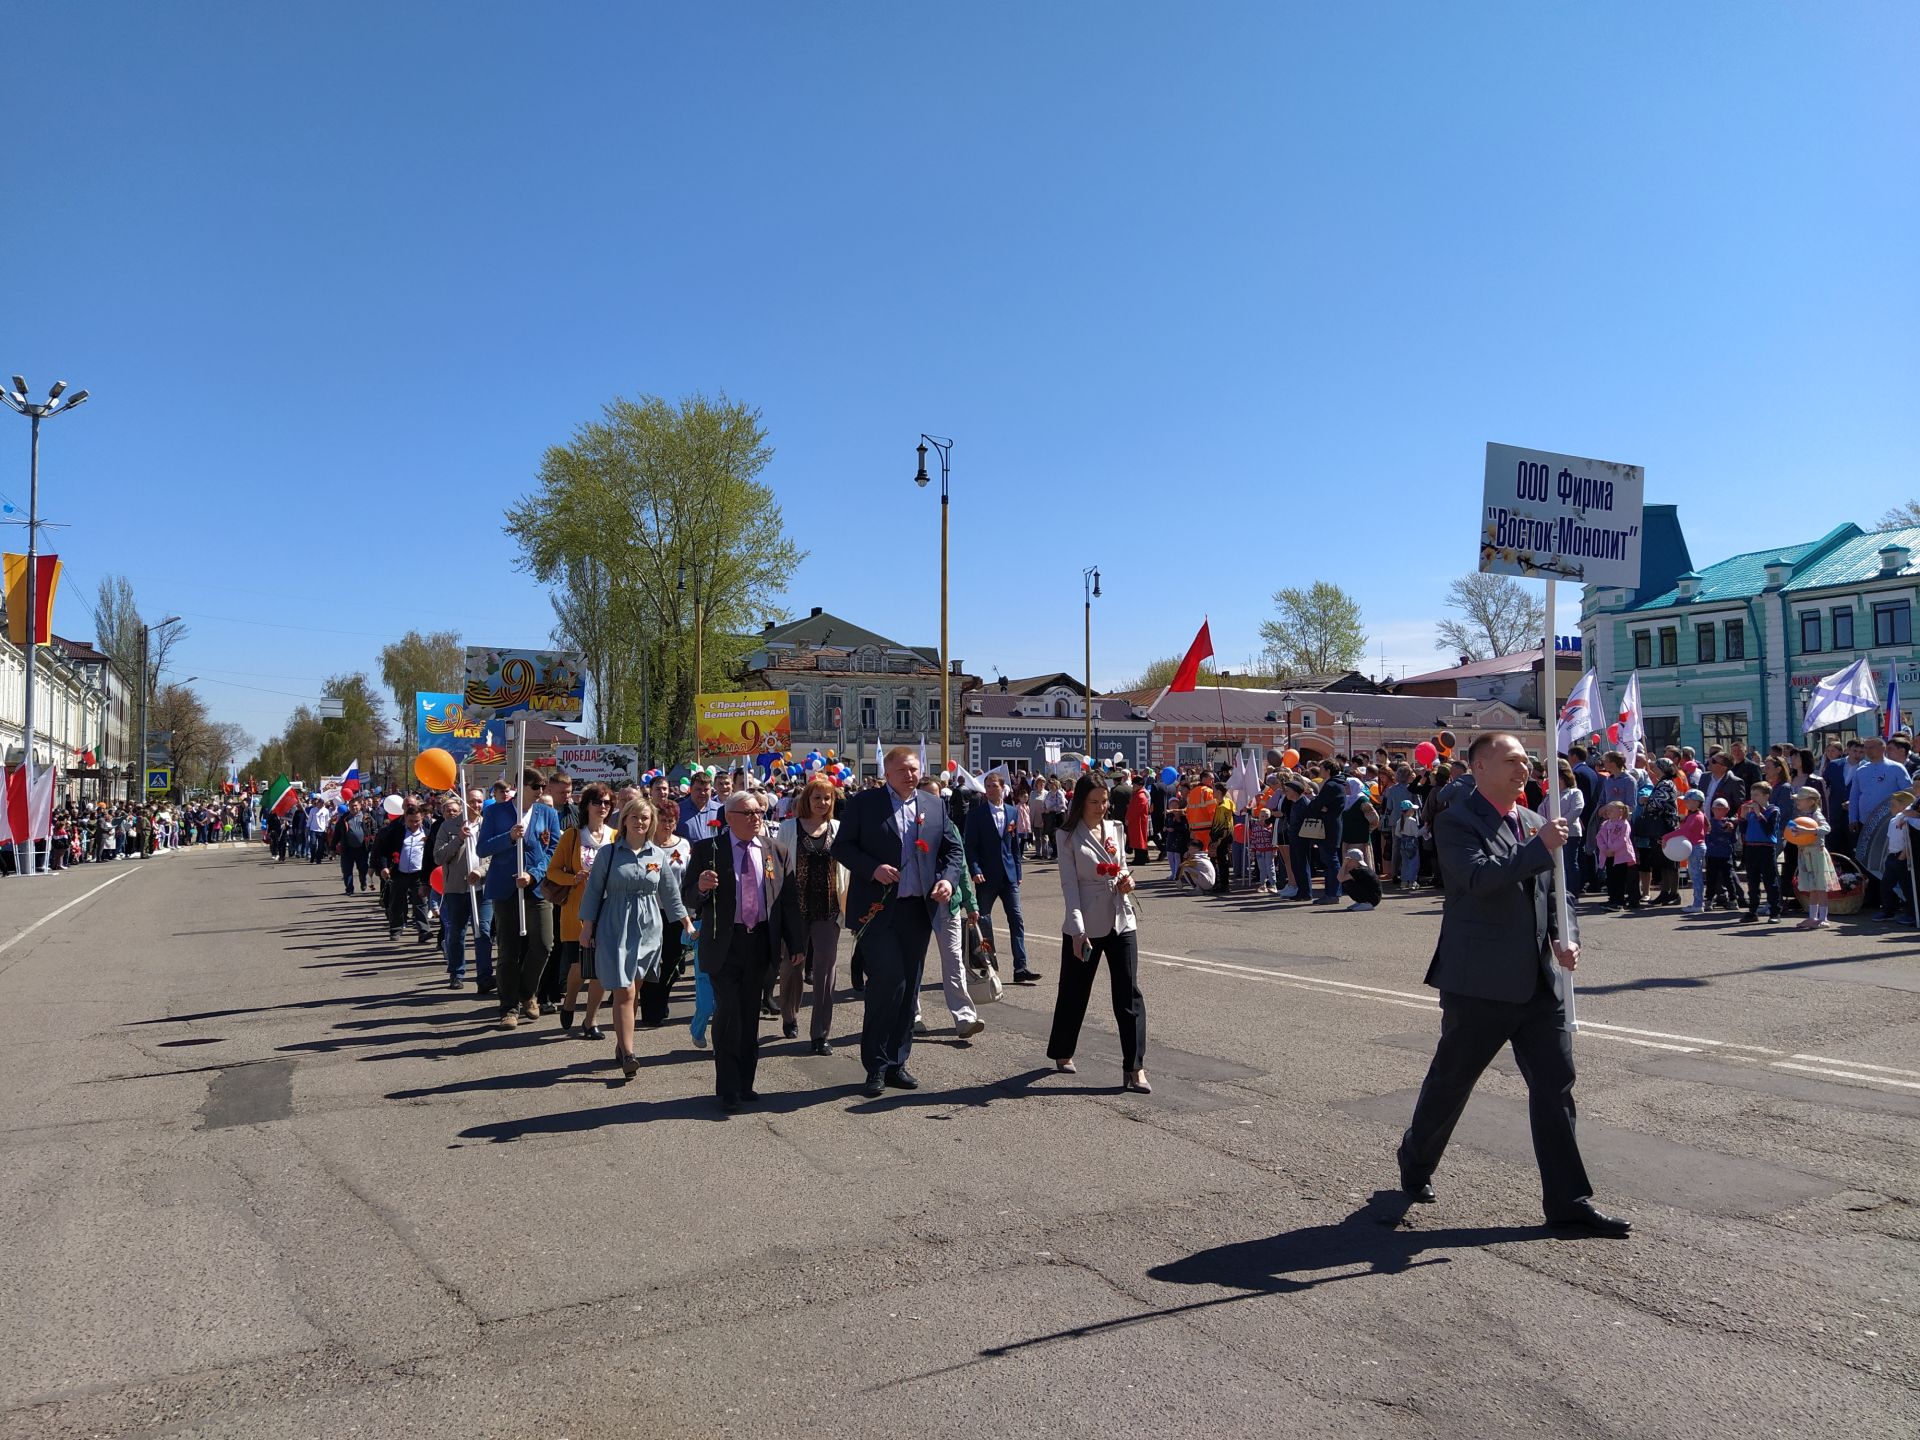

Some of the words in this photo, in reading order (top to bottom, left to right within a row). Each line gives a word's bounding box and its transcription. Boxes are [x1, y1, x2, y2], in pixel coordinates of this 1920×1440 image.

[1517, 460, 1550, 503] ООО
[1557, 467, 1614, 514] Фирма
[529, 695, 580, 711] МАЯ
[717, 699, 775, 710] Праздником
[704, 708, 746, 719] Великой
[747, 707, 786, 717] Победы!
[453, 727, 481, 739] МАЯ
[740, 719, 760, 753] 9
[726, 743, 748, 752] МАЯ
[1001, 737, 1022, 748] café
[1099, 741, 1123, 752] кафе
